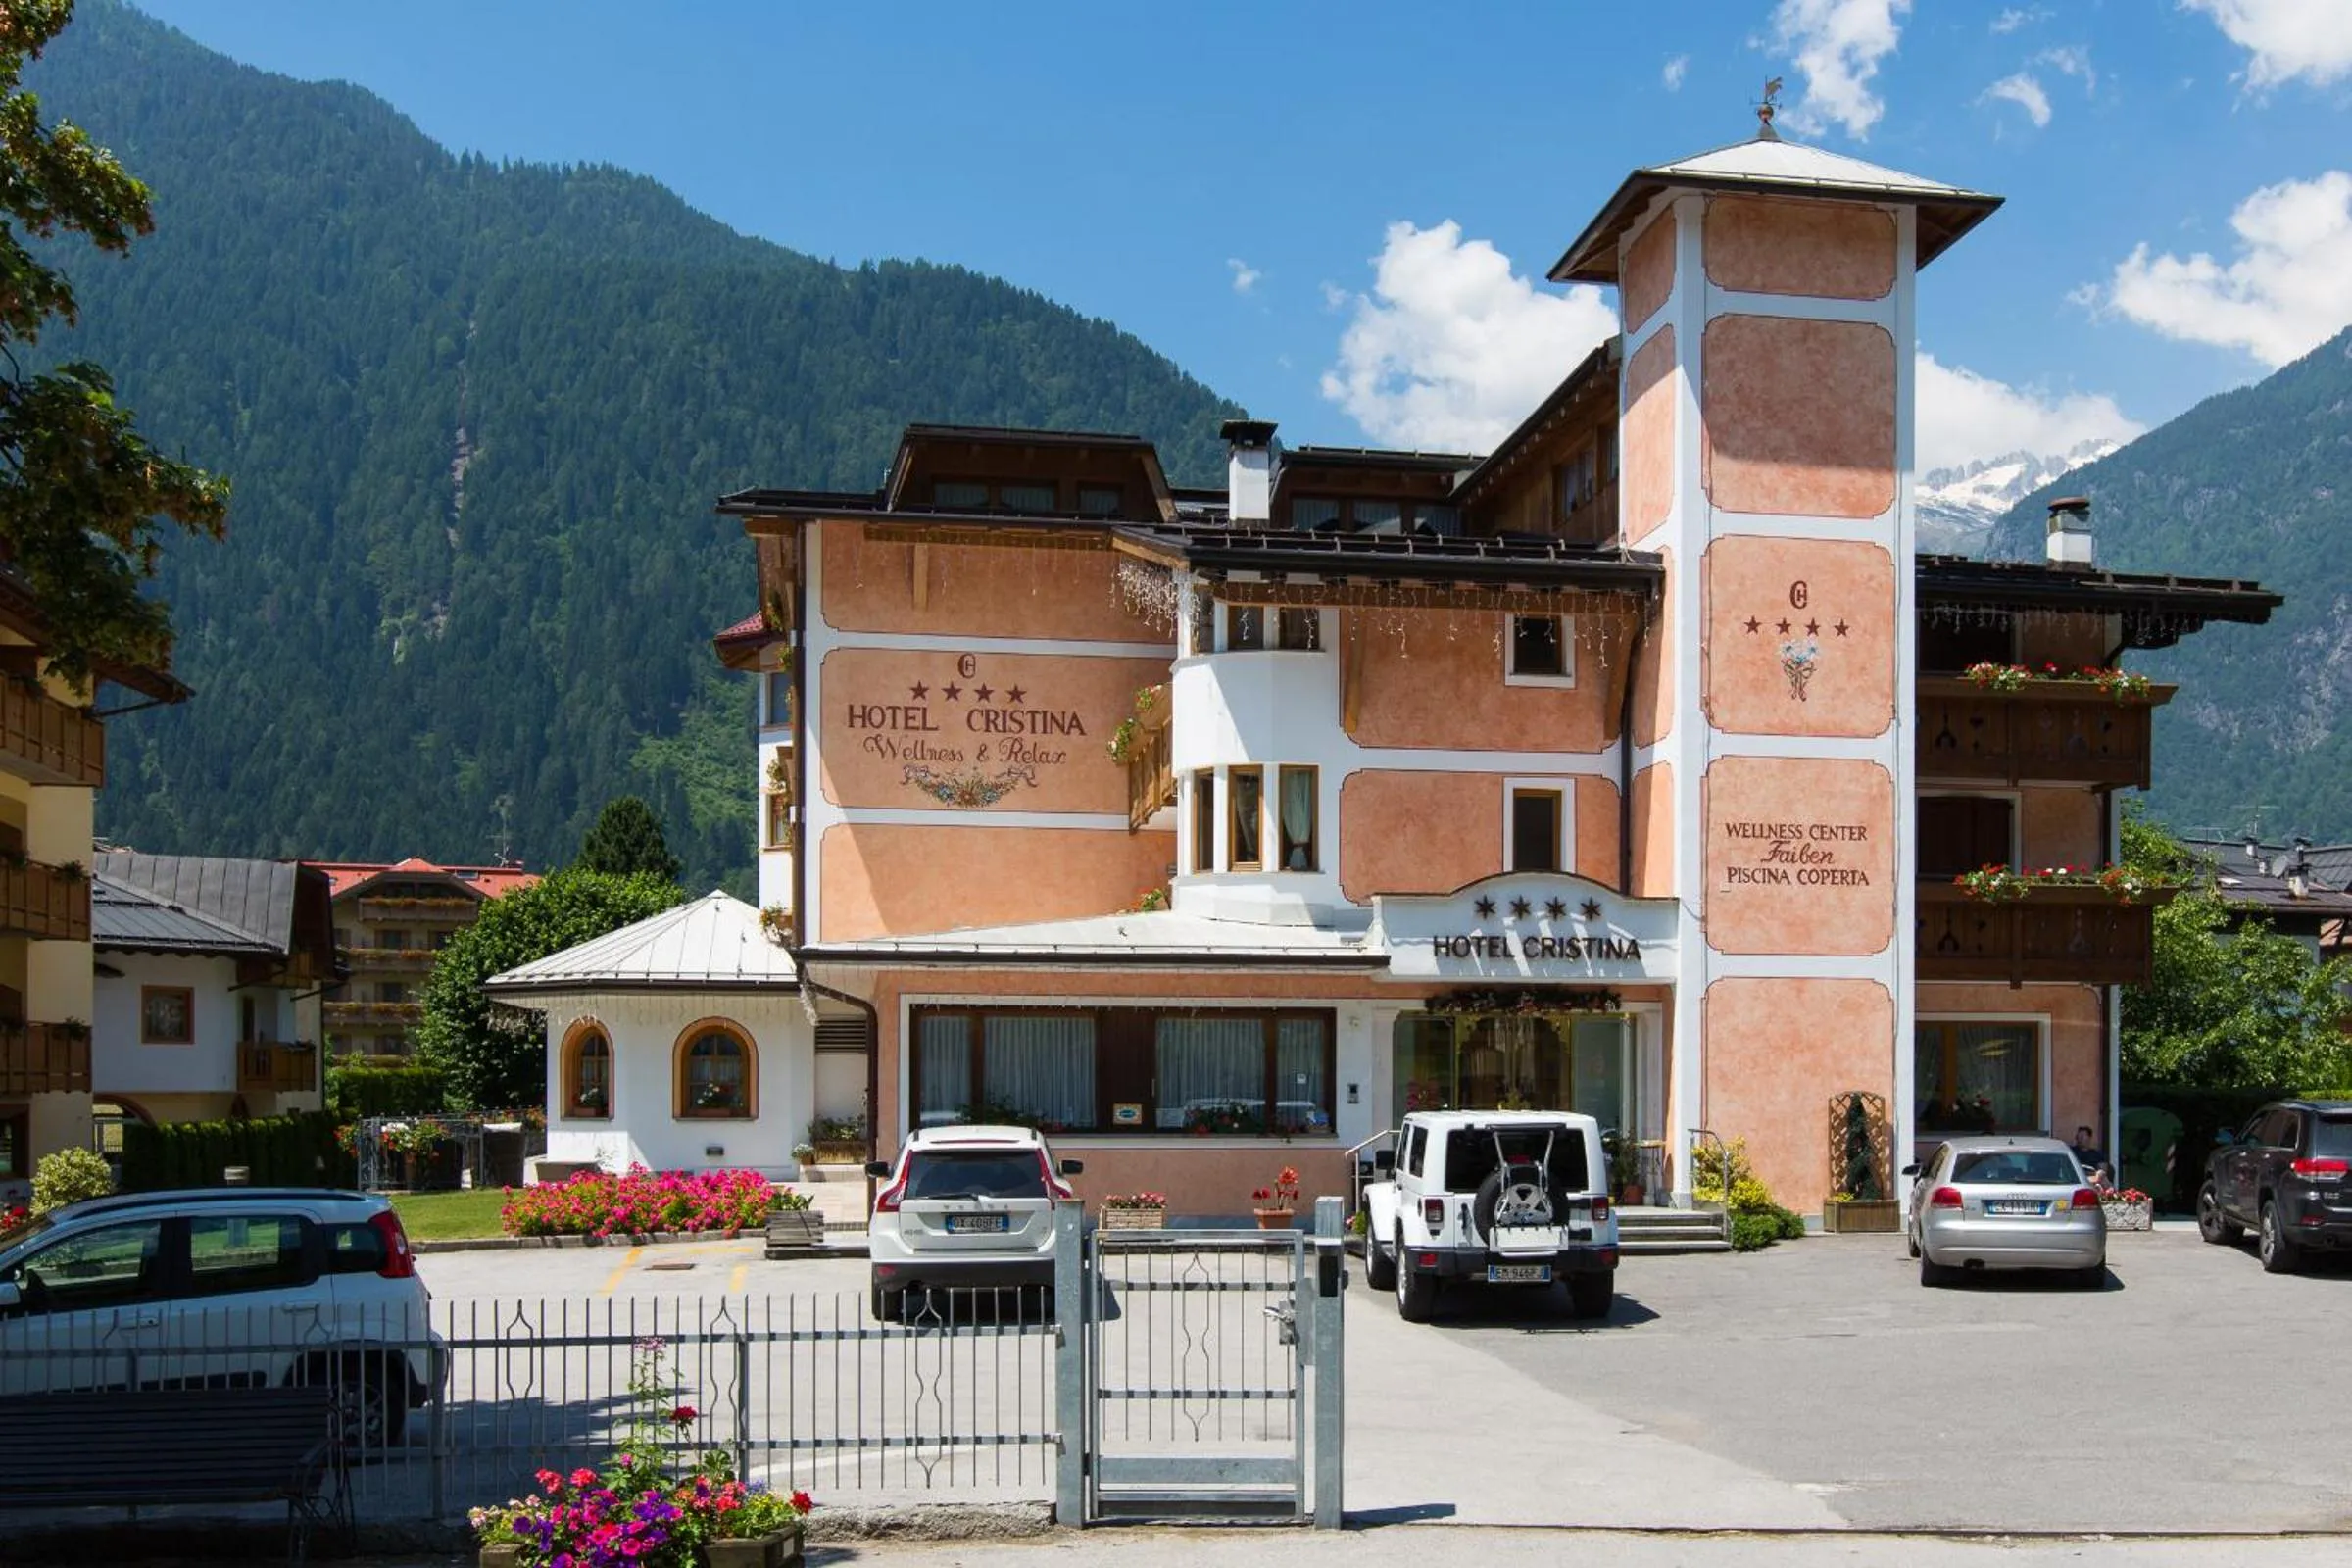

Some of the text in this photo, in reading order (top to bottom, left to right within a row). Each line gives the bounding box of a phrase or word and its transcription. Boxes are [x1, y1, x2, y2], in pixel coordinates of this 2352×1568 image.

[848, 705, 1087, 736] HOTEL CRISTINA
[863, 735, 1066, 764] Wellness & Relax
[1725, 823, 1868, 841] WELLNESS CENTER
[1727, 866, 1870, 887] PISCINA COPERTA
[1434, 935, 1642, 960] HOTEL CRISTINA
